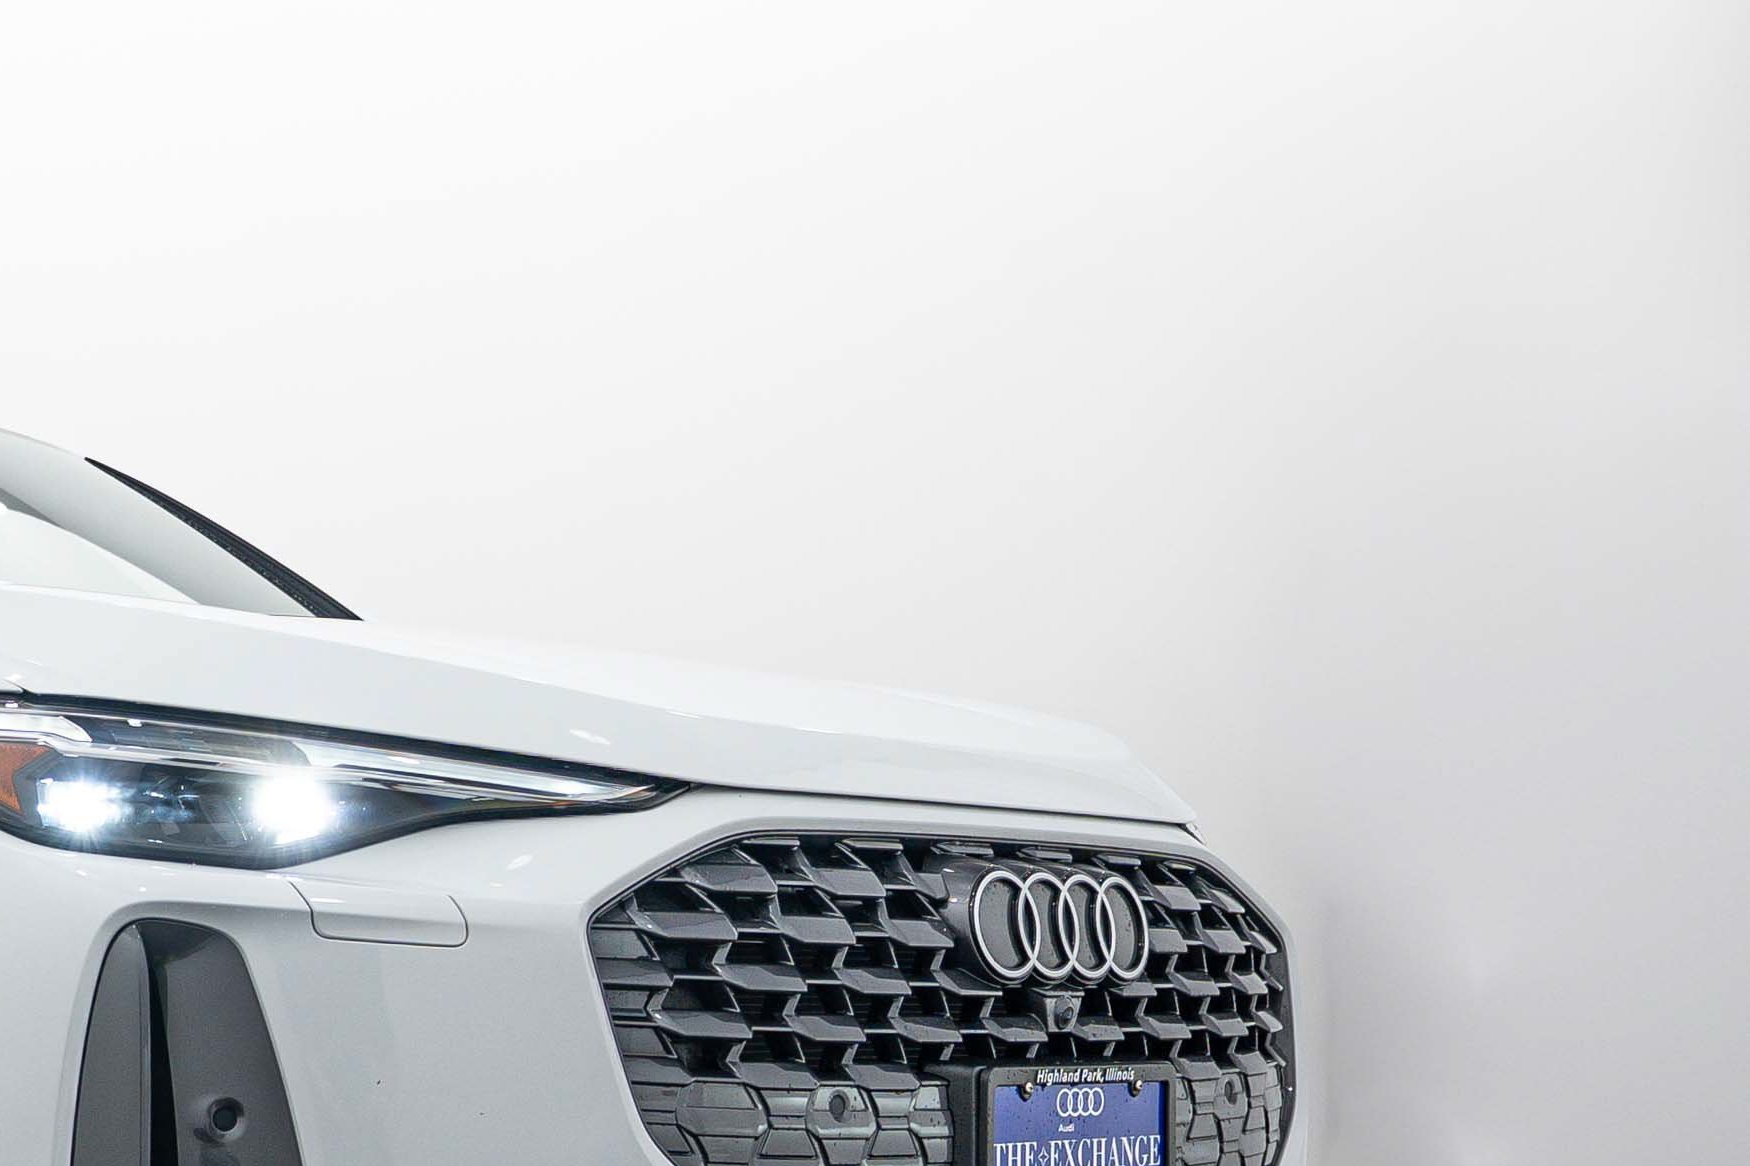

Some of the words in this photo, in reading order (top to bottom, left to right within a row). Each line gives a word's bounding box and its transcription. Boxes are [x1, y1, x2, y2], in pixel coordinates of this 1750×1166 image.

[1037, 1069, 1080, 1086] Highland
[1082, 1067, 1104, 1083] Park,
[1105, 1066, 1135, 1081] Illinois
[1058, 1123, 1075, 1132] Audi
